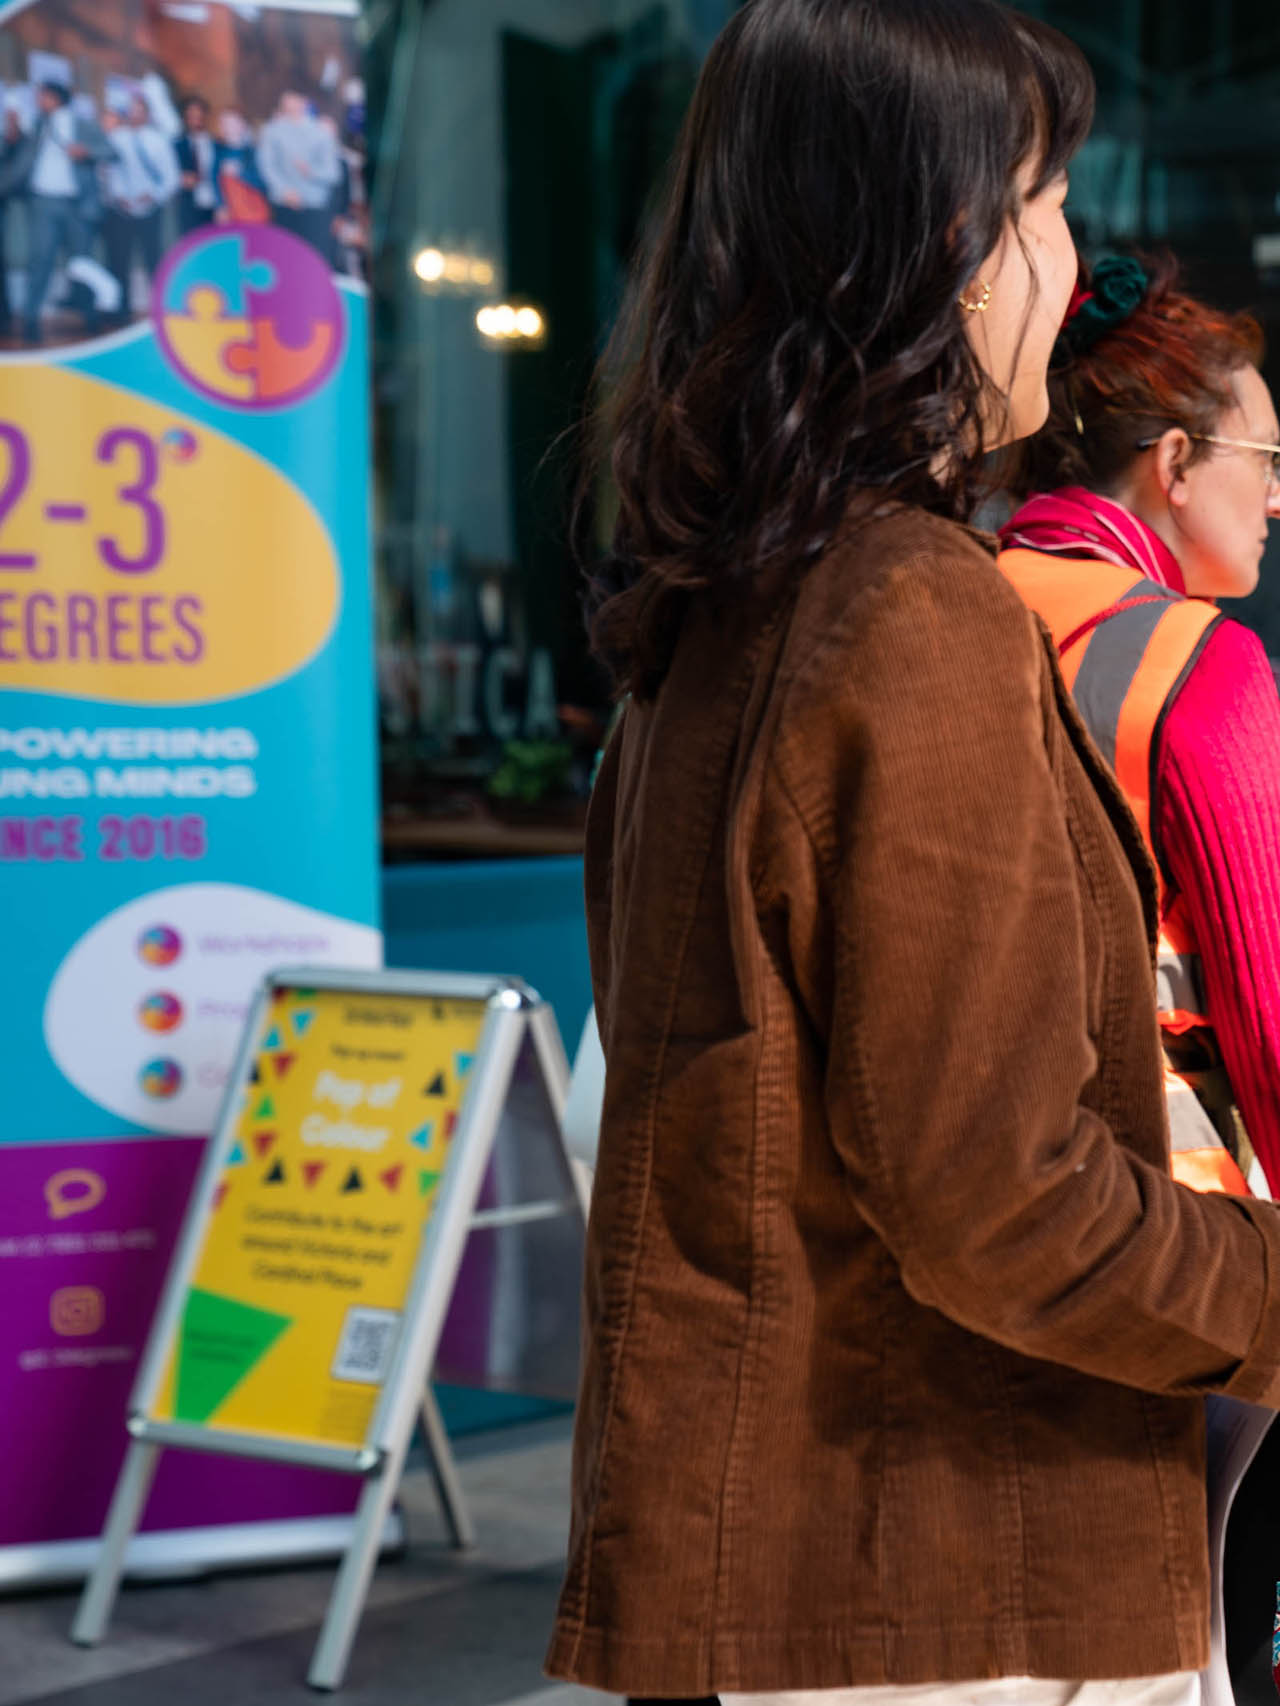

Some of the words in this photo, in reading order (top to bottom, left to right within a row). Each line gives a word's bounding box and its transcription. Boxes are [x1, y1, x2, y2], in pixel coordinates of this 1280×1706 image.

[0, 594, 205, 663] EGREES
[0, 766, 90, 798] NG
[95, 766, 257, 798] MINDS
[99, 814, 206, 862] 2016
[313, 1070, 364, 1112] Pop
[366, 1076, 404, 1109] of
[301, 1113, 391, 1153] Colour
